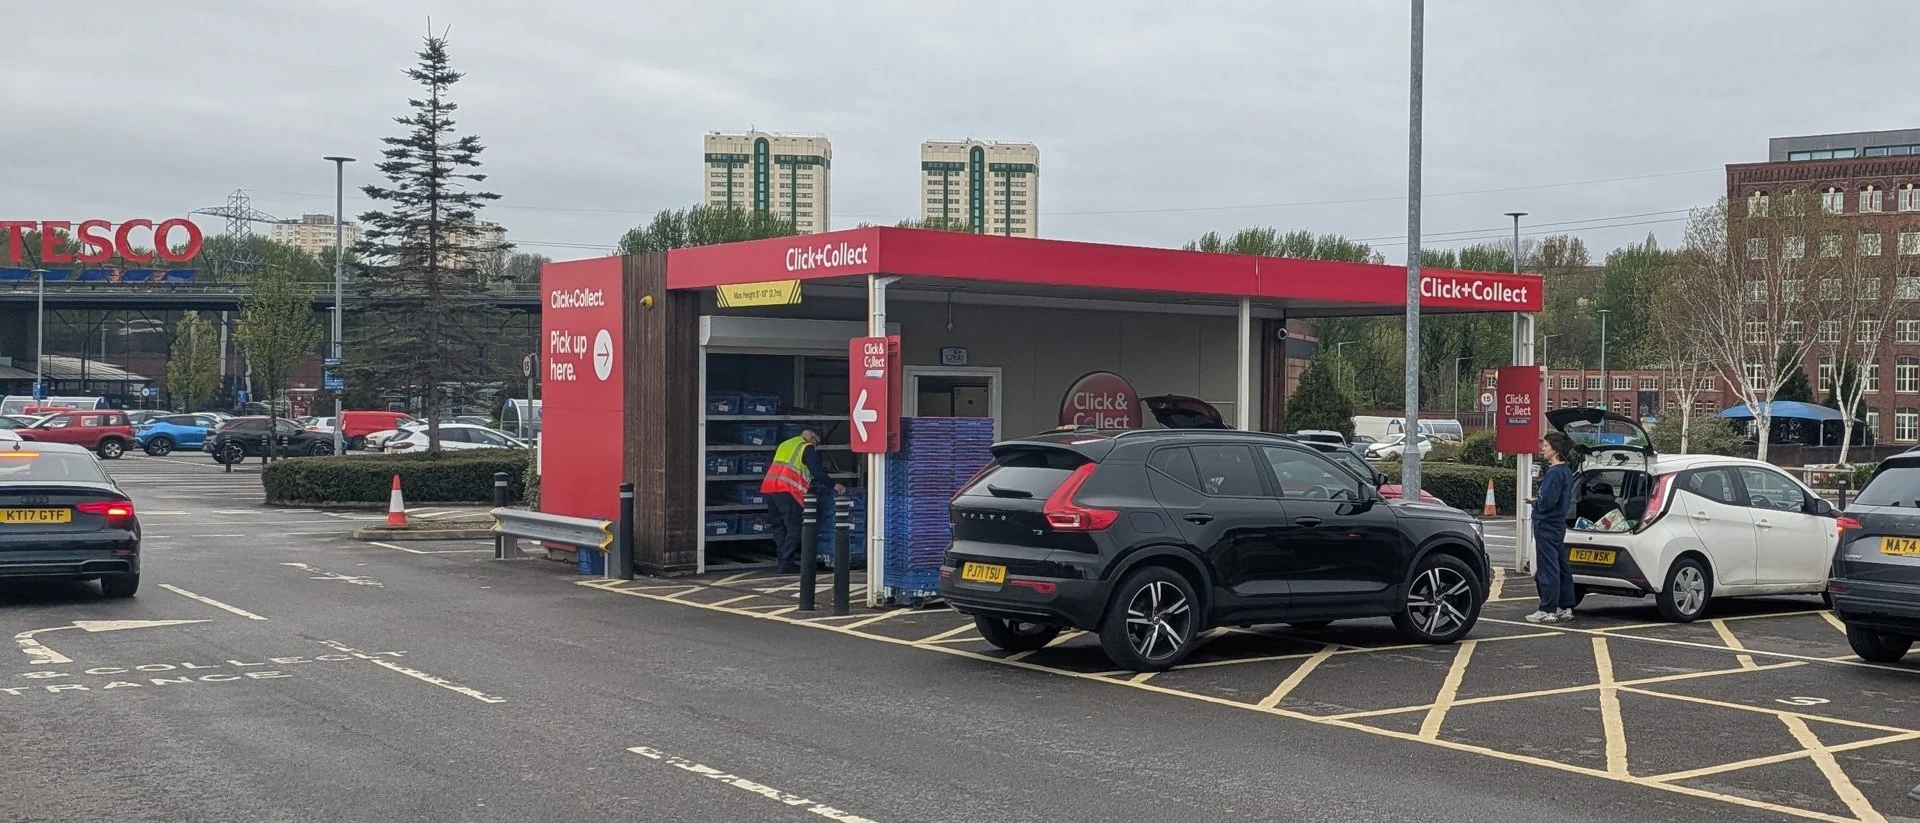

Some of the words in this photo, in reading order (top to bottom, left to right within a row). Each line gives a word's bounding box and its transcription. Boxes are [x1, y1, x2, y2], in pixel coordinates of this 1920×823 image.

[0, 218, 204, 264] TESCO
[785, 242, 868, 271] Click+Collect
[1420, 277, 1528, 303] Click+Collect
[550, 330, 571, 354] Pick
[574, 335, 588, 360] up
[864, 343, 879, 355] Click
[550, 357, 576, 381] here.
[1073, 392, 1113, 410] Click
[1115, 392, 1128, 410] &
[1505, 393, 1523, 404] Click
[6, 510, 36, 521] KT17
[39, 510, 65, 520] GTF
[962, 512, 1007, 520] VOLVO
[1885, 538, 1917, 552] MA74
[1575, 550, 1592, 561] YE17
[966, 564, 984, 578] PJ71
[985, 566, 1001, 580] TSU
